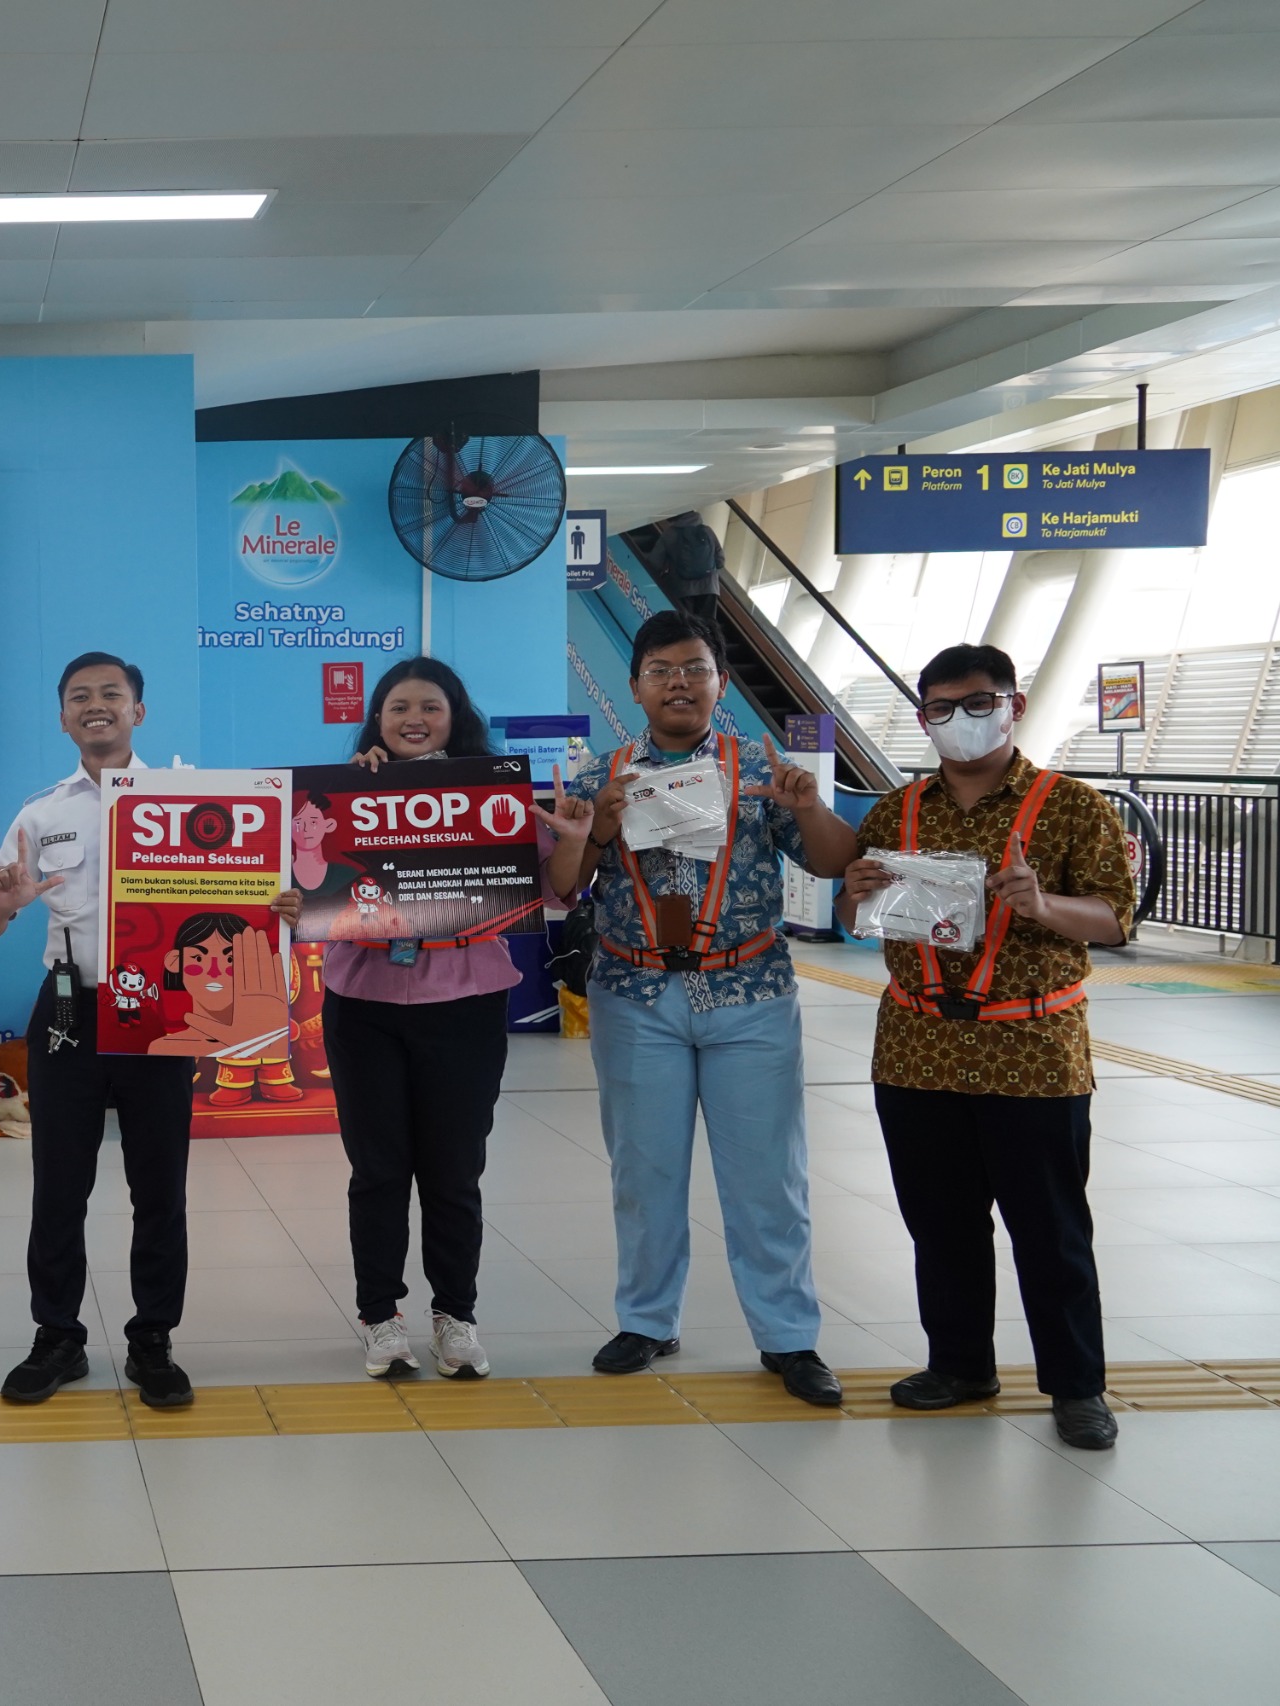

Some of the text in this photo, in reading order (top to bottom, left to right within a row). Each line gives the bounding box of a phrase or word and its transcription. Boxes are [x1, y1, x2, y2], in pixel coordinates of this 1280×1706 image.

[923, 466, 962, 478] Peron
[1043, 462, 1136, 478] Ke Jati Mulya
[977, 465, 989, 490] 1
[1042, 478, 1106, 490] To Jati Mulya
[922, 481, 962, 491] Platform
[276, 515, 300, 537] Le
[1042, 511, 1139, 527] Ke Harjamukti
[1041, 527, 1107, 539] To Harjamukti
[242, 535, 336, 555] Minerale
[582, 569, 595, 577] Pria
[607, 555, 631, 596] nerale
[235, 602, 345, 625] Sehatnya
[198, 627, 404, 651] ineral Terlindungi
[567, 642, 634, 747] ehatnya Minera
[509, 745, 565, 755] Pengisi Baterai
[633, 787, 655, 799] STOP
[351, 792, 470, 832] STOP
[132, 802, 265, 850] STOP
[354, 832, 474, 847] PELECEHAN SEKSUAL
[132, 852, 264, 865] Pelecehan Seksual
[397, 866, 517, 878] BERANI MENOLAK DAN MELAPOR
[121, 877, 143, 885] Diam
[144, 877, 171, 885] bukan
[200, 879, 238, 887] Bersama
[257, 879, 275, 887] bisa
[398, 876, 533, 890] ADALAH LANGKAH AWAL MELINDUNGI
[126, 887, 269, 898] menghentikan pelecehan seksual.
[399, 890, 467, 902] DIRI DAN SESAMA.
